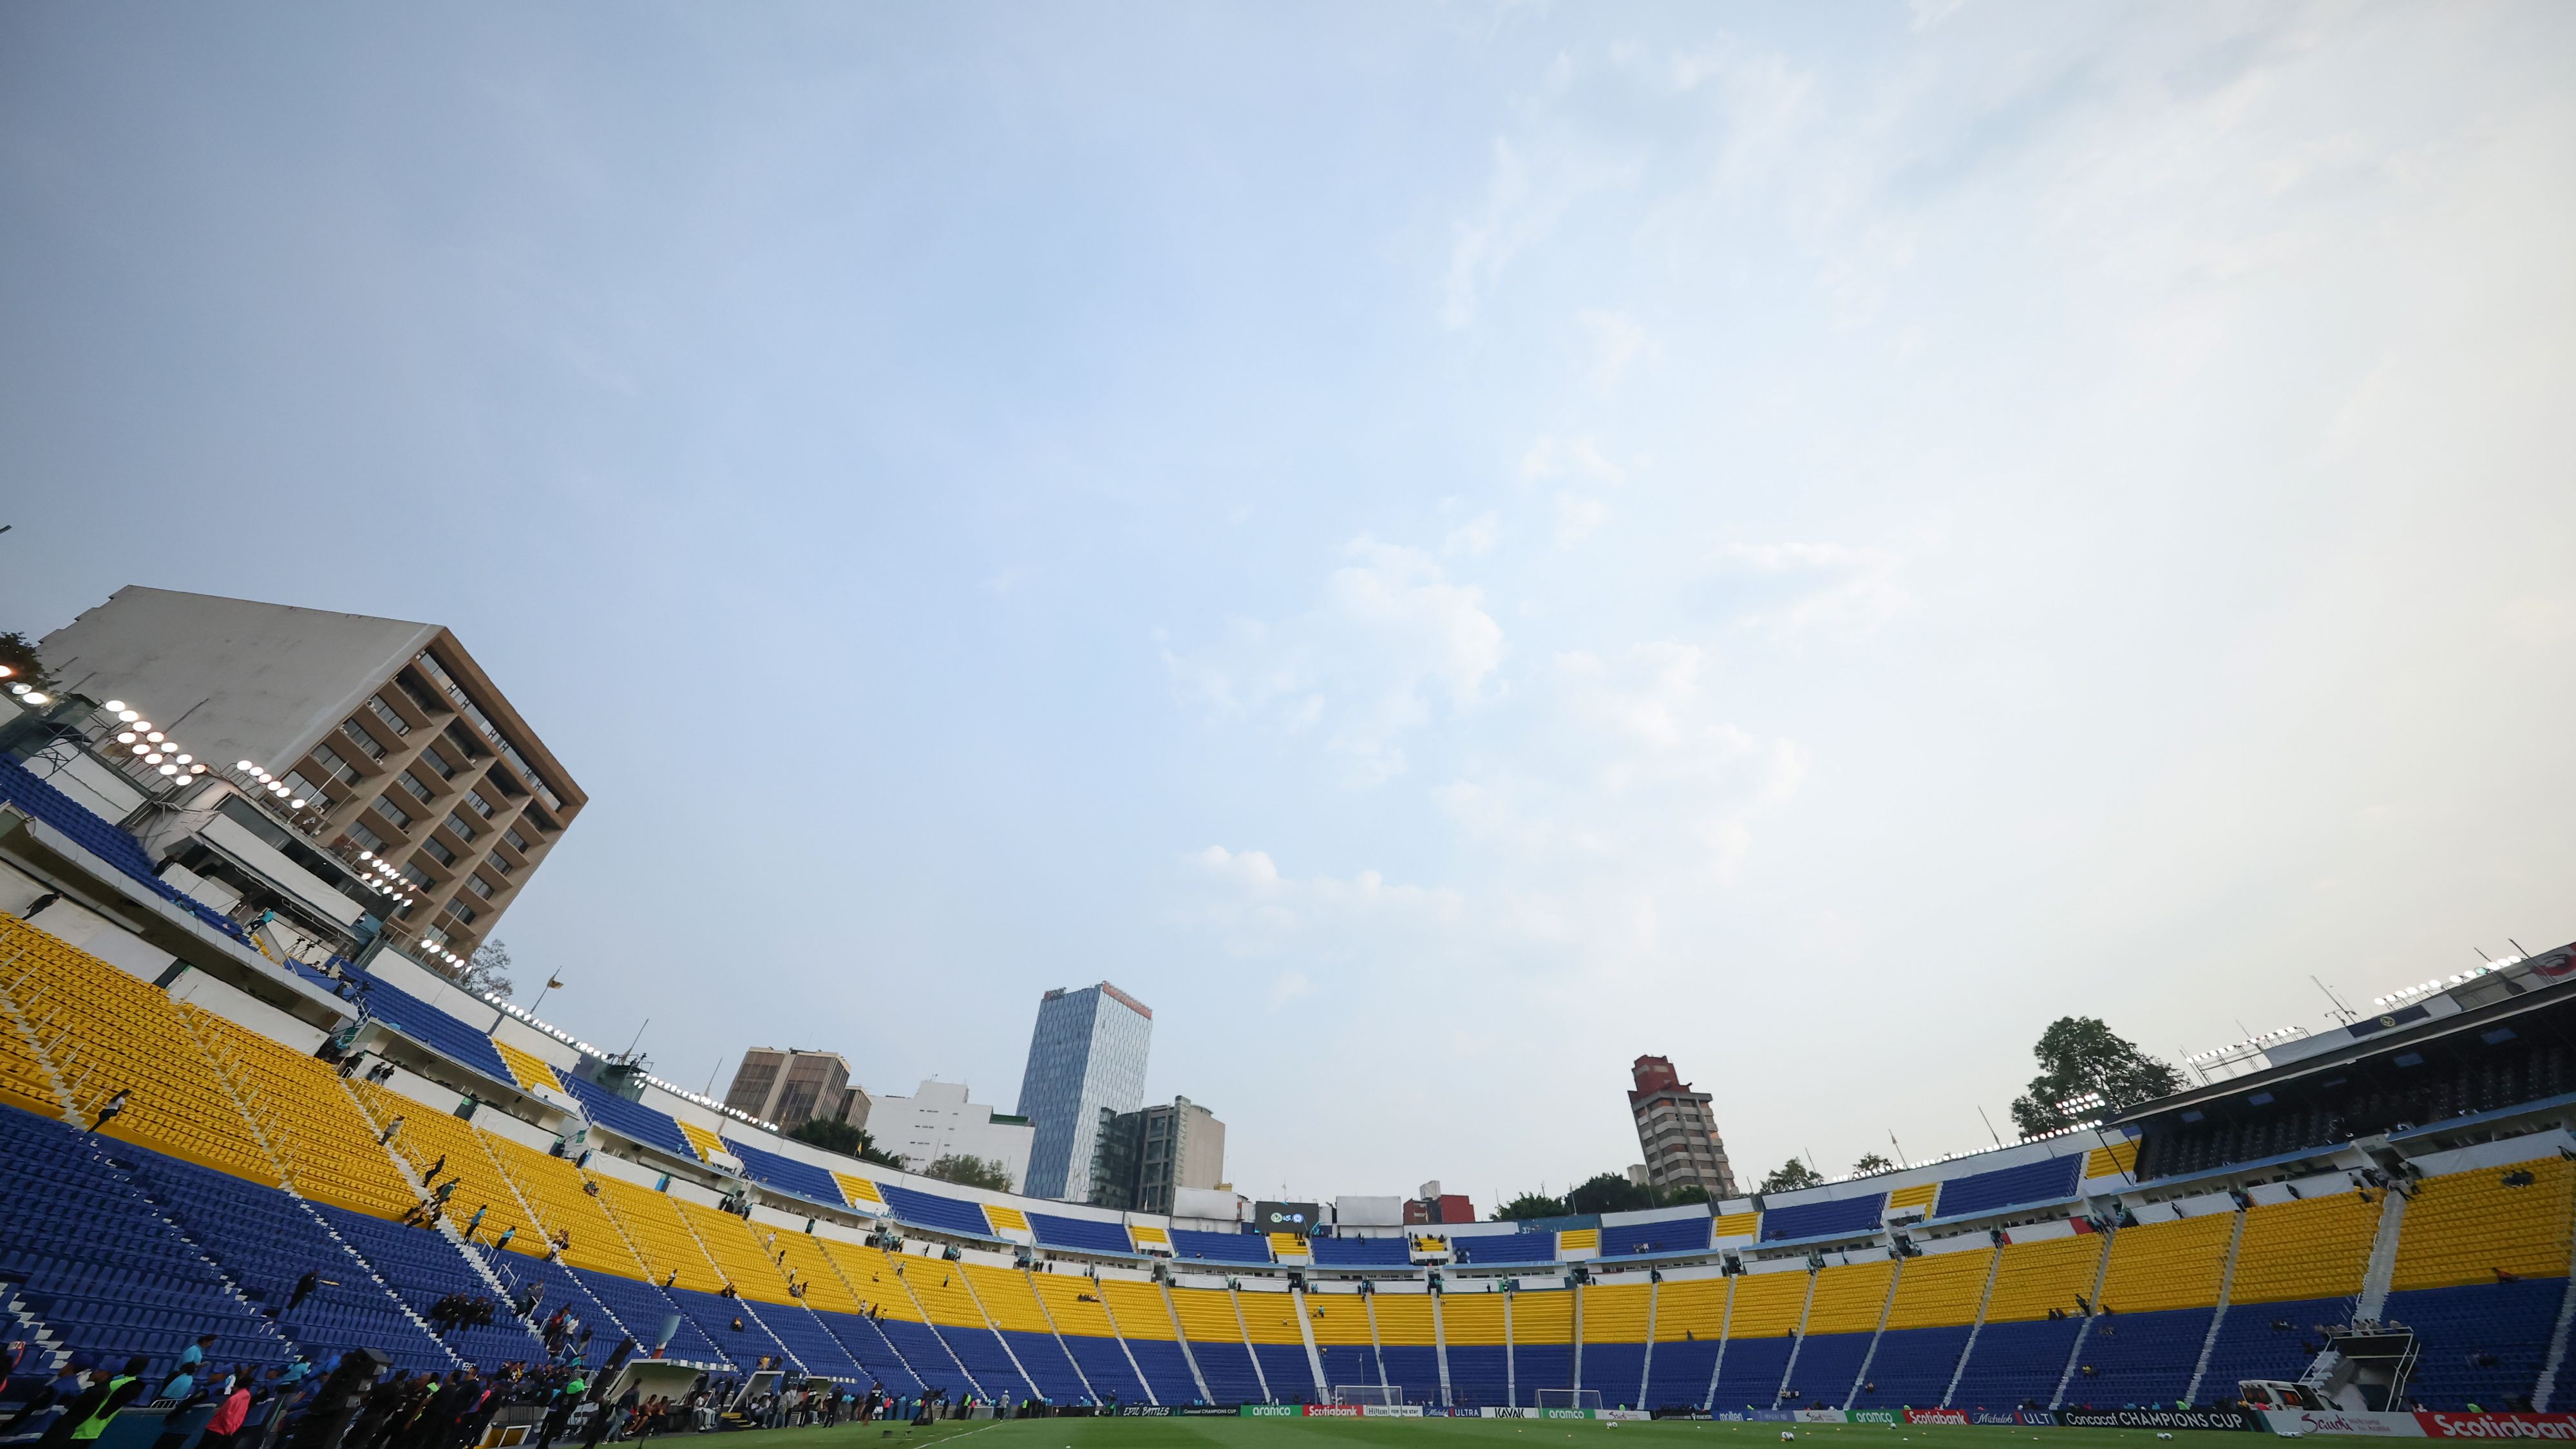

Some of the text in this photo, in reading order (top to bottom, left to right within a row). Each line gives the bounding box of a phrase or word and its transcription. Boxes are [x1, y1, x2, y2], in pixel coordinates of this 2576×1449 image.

[1123, 1406, 1170, 1417] EPIC BATTLES
[1253, 1406, 1291, 1416] aramco
[1309, 1406, 1357, 1417] Scotiabank
[1368, 1407, 1388, 1416] Hilton
[1454, 1408, 1479, 1417] ULTRA
[1495, 1408, 1525, 1418] KAVAK
[1549, 1410, 1584, 1419] aramco
[1719, 1411, 1743, 1422] molten
[1856, 1412, 1893, 1423] aramco
[1909, 1410, 1967, 1425] Scotiabank
[1973, 1413, 2013, 1425] Michelob
[2066, 1412, 2242, 1428] Concacaf CHAMPIONS CUP
[2301, 1413, 2354, 1433] Saudi
